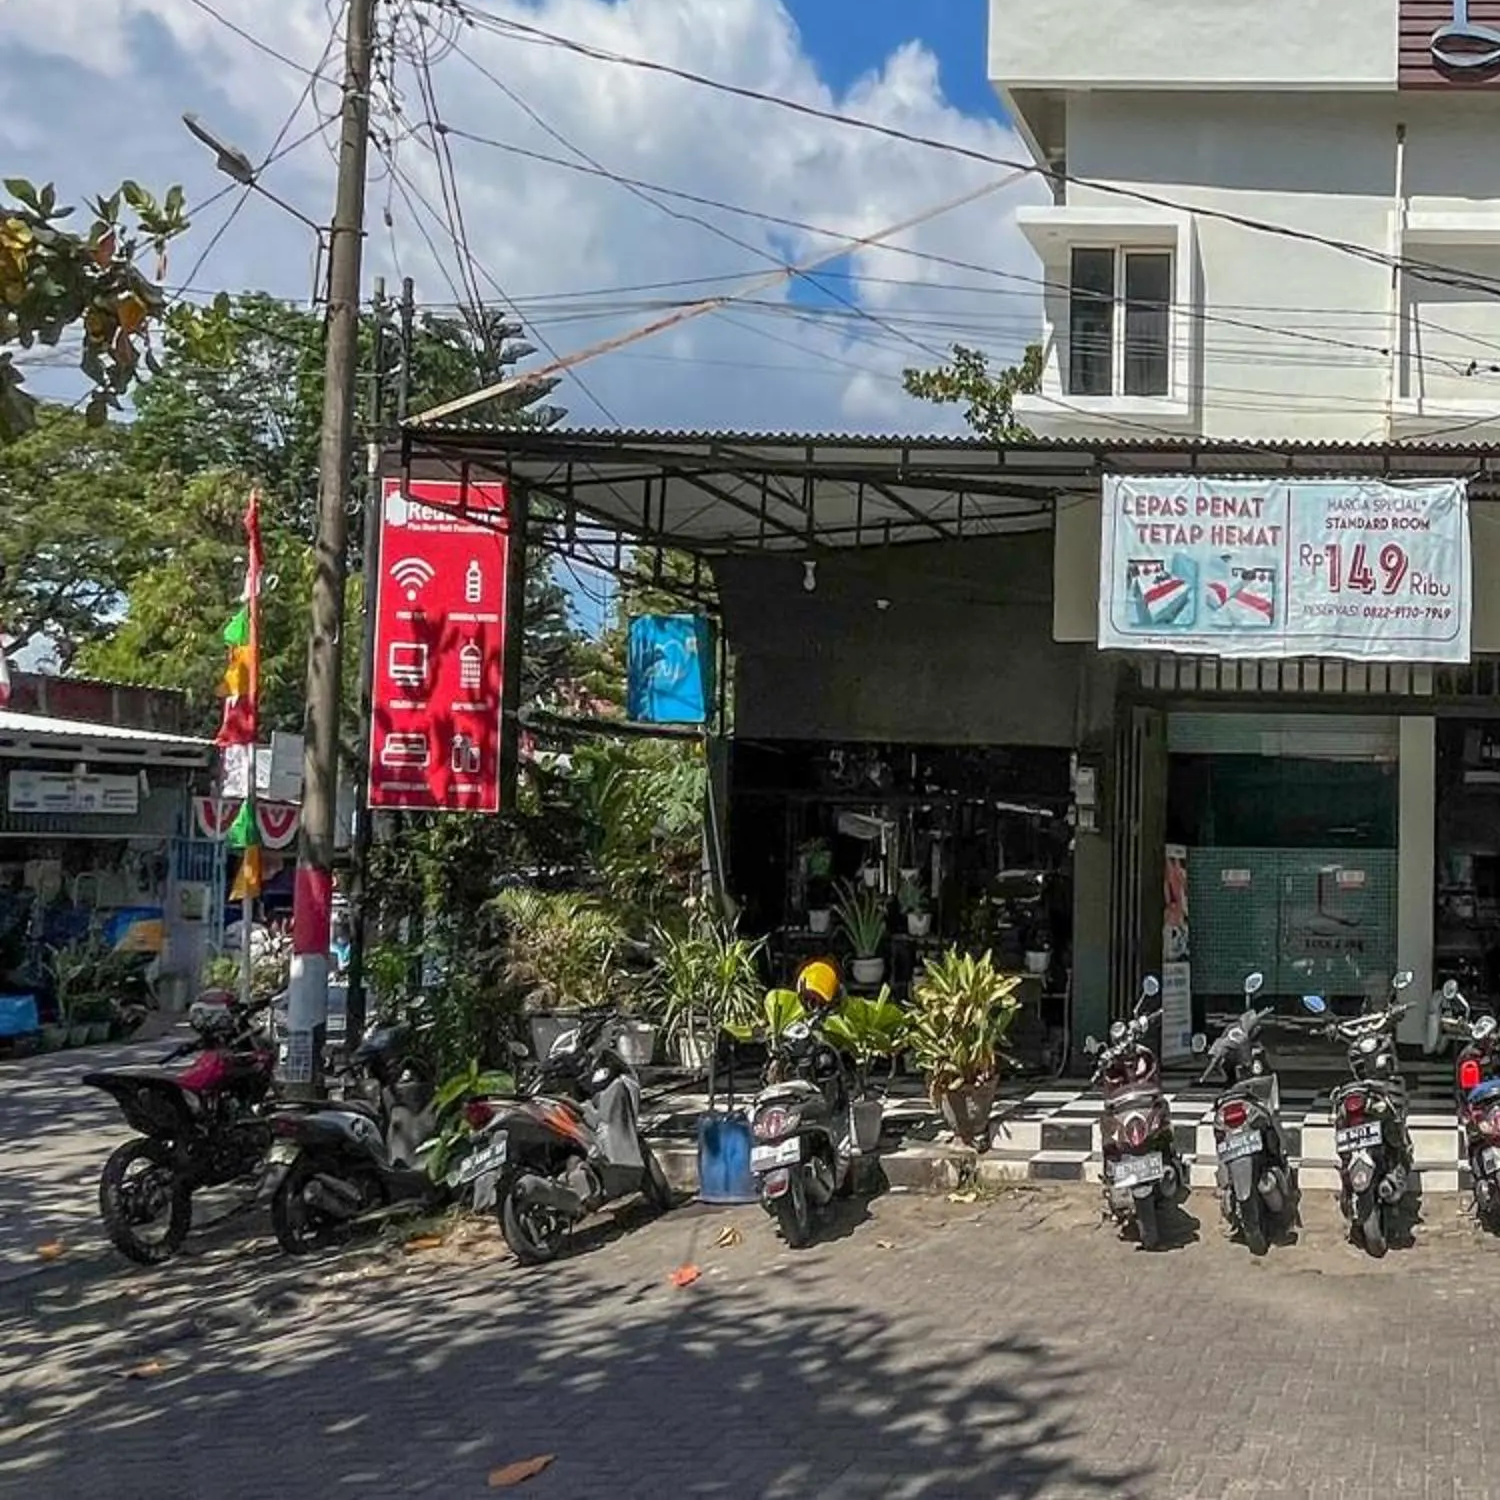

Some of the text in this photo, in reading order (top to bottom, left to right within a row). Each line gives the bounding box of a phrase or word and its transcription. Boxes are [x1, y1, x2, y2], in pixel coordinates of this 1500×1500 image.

[1122, 495, 1265, 518] LEPAS PENAT
[1135, 523, 1283, 546] TETAP HEMAT
[1325, 517, 1431, 531] STANDARD ROOM
[1299, 543, 1451, 597] Rp 149 Ribu
